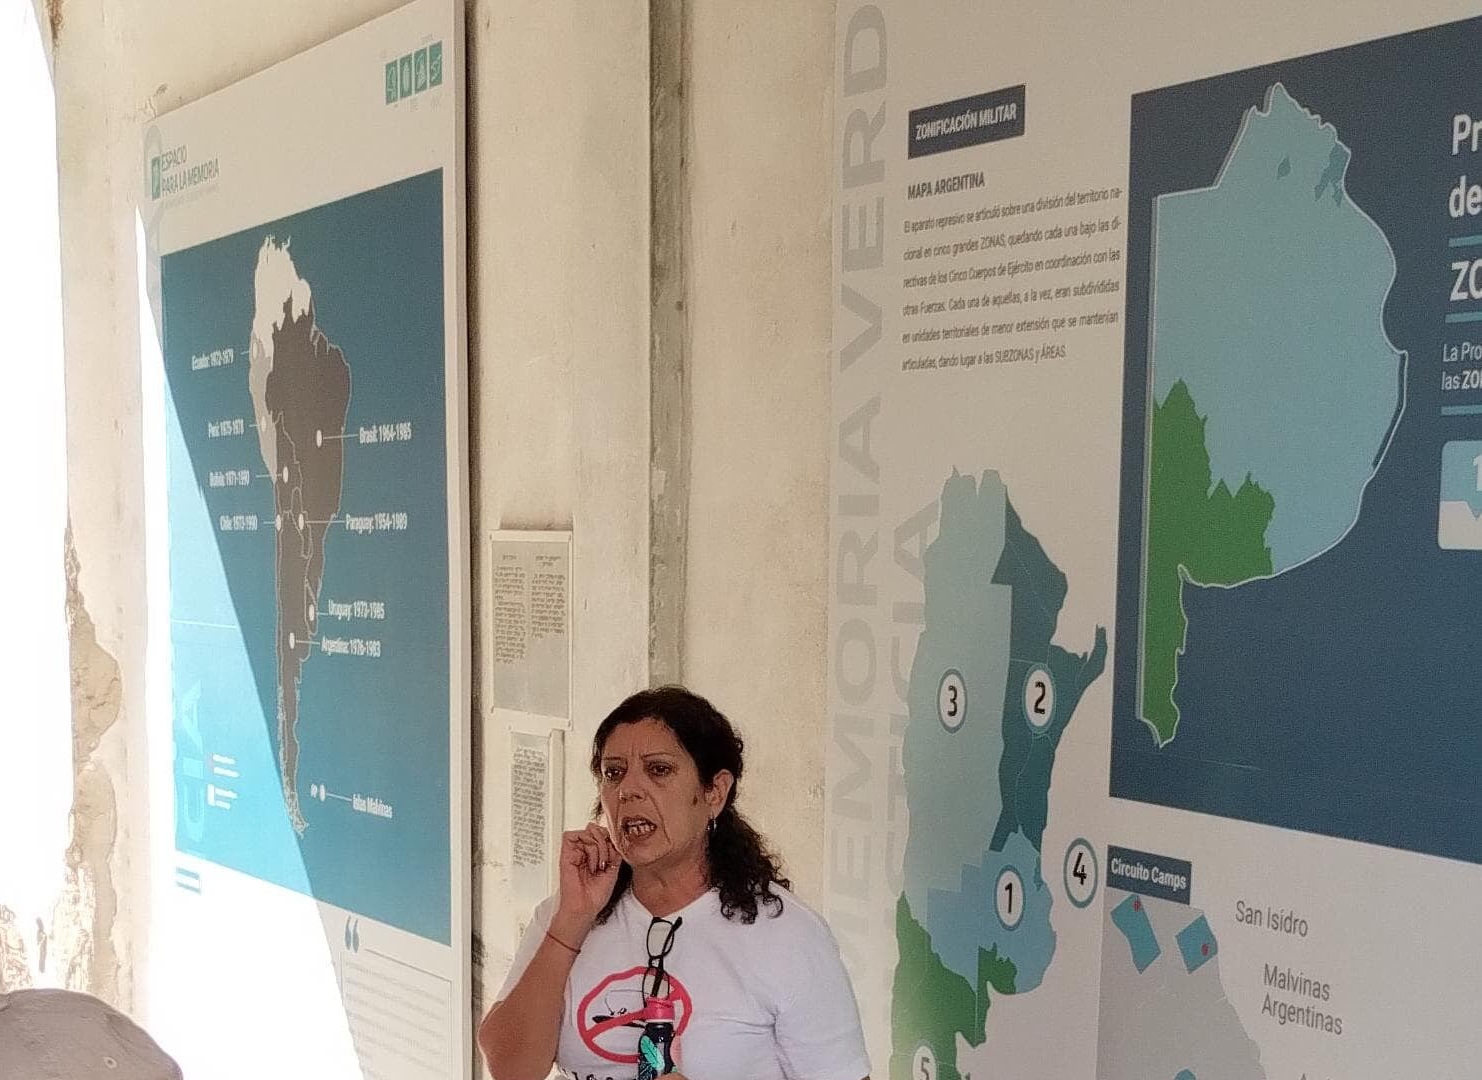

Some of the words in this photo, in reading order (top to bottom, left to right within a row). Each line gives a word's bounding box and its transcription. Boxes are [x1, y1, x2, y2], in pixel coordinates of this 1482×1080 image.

[915, 109, 977, 141] ZONIFICACIÓN
[979, 103, 1017, 127] MILITAR
[161, 145, 187, 173] ESPACIO
[162, 174, 178, 194] PARA
[179, 169, 187, 190] LA
[188, 158, 219, 186] MEMORIA
[908, 182, 932, 200] MAPA
[934, 172, 985, 195] ARGENTINA
[1448, 174, 1482, 219] de
[936, 212, 965, 230] represivo
[1001, 201, 1020, 216] sobre
[1021, 202, 1034, 214] una
[1036, 195, 1063, 212] división
[1064, 191, 1075, 207] del
[1077, 188, 1109, 206] territorio
[903, 245, 923, 261] cional
[924, 247, 932, 258] en
[934, 243, 951, 256] cinco
[952, 239, 979, 258] grandes
[1008, 228, 1043, 249] quedando
[1044, 224, 1063, 240] cada
[1064, 225, 1078, 238] una
[1079, 220, 1096, 239] bajo
[1097, 218, 1109, 233] las
[928, 271, 936, 286] de
[938, 269, 947, 283] los
[998, 262, 1006, 276] de
[1035, 260, 1043, 271] en
[1045, 251, 1091, 270] coordinación
[1093, 251, 1107, 264] con
[1109, 247, 1120, 261] las
[949, 296, 966, 310] Cada
[967, 298, 979, 309] una
[981, 293, 990, 307] de
[1055, 286, 1070, 299] eran
[1073, 278, 1120, 296] subdivididas
[902, 332, 910, 343] en
[942, 324, 979, 340] territoriales
[981, 322, 990, 336] de
[1015, 316, 1050, 333] extensión
[1052, 316, 1065, 332] que
[1068, 316, 1077, 327] se
[939, 353, 958, 368] dando
[959, 353, 976, 369] lugar
[983, 350, 993, 364] las
[995, 347, 1034, 364] SUBZONAS
[1442, 343, 1458, 363] La
[1440, 371, 1460, 391] las
[1461, 370, 1482, 390] ZO
[946, 684, 959, 718] 3
[1032, 681, 1047, 715] 2
[1071, 852, 1088, 886] 4
[1110, 857, 1150, 880] Circuito
[1151, 866, 1187, 892] Camps
[1004, 881, 1014, 914] 1
[1235, 900, 1263, 927] San
[1266, 906, 1309, 938] Isidro
[1263, 963, 1331, 1001] Malvinas
[1261, 992, 1343, 1036] Argentinas
